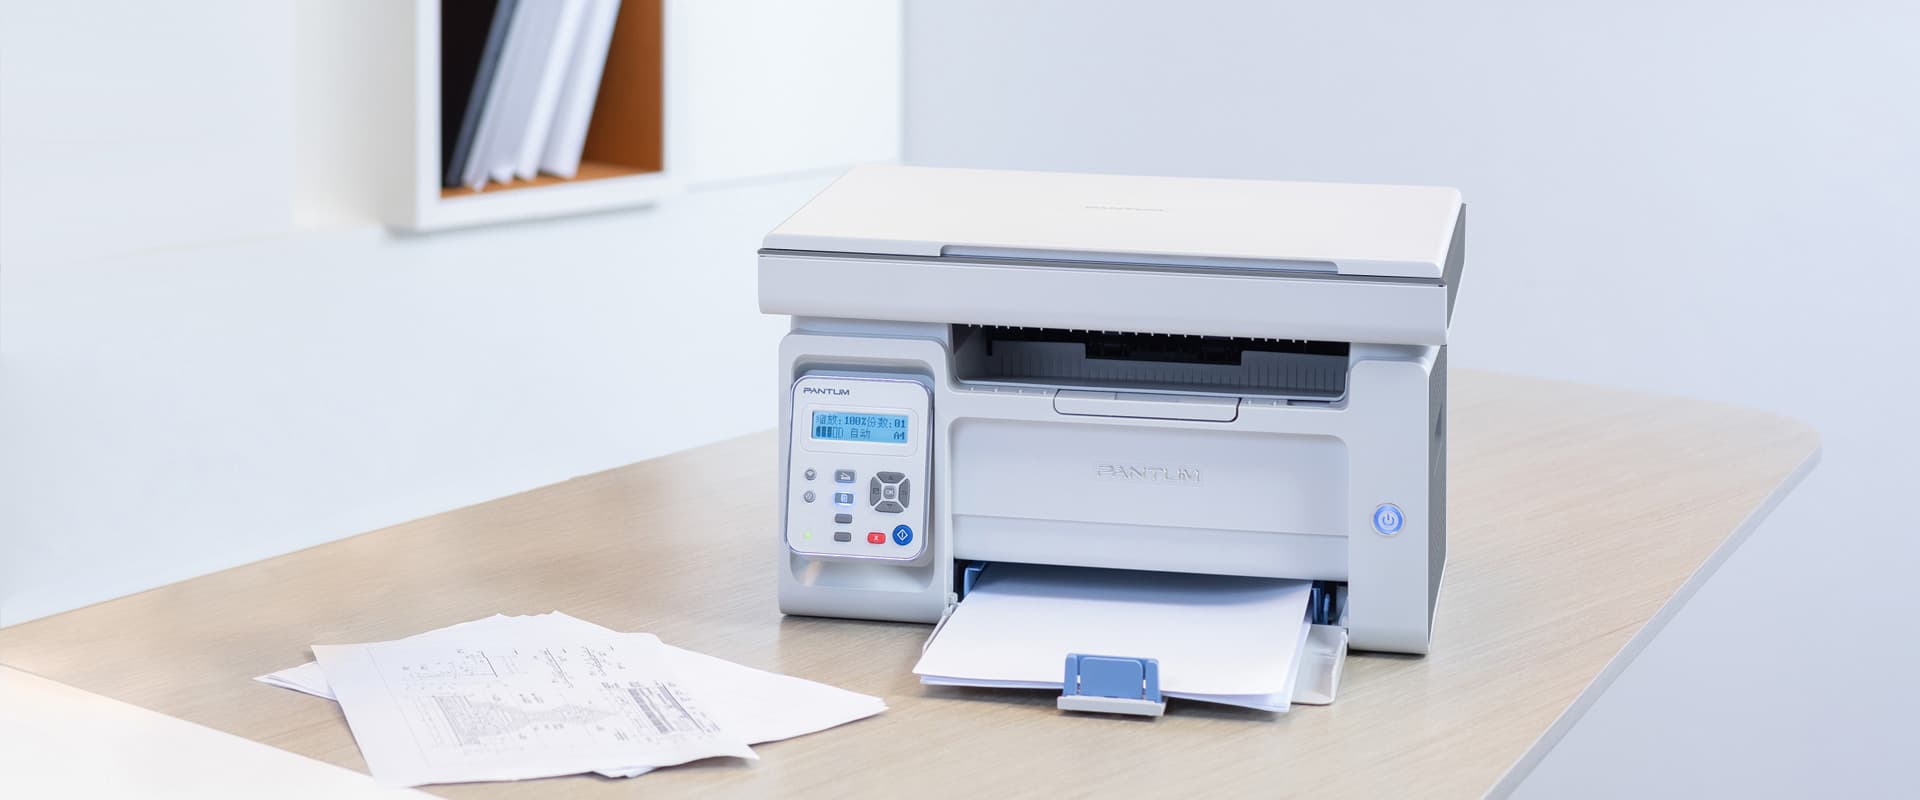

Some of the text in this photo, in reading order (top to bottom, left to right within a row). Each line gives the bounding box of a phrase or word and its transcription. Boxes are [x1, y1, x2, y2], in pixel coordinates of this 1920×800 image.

[803, 387, 850, 396] PANTUM
[850, 428, 905, 440] 自动 A4
[1096, 464, 1200, 482] PANTUM
